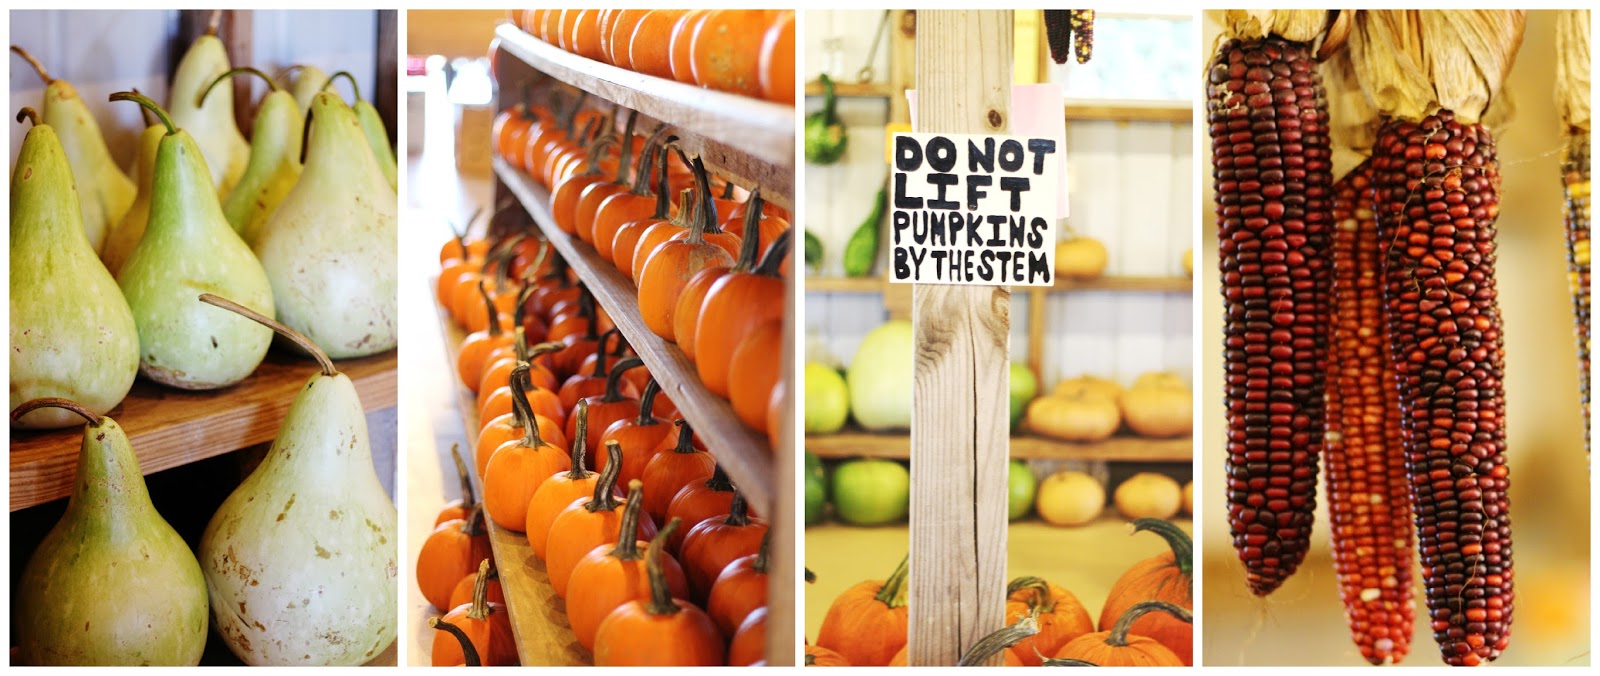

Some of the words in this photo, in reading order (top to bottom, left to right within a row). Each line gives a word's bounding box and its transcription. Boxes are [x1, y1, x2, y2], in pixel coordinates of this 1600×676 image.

[895, 135, 957, 172] DO
[968, 137, 1056, 175] NOT
[894, 172, 1030, 212] LIFT
[893, 210, 1048, 249] PUMPKINS
[894, 246, 927, 280] BY
[930, 249, 975, 282] THE
[977, 249, 1050, 284] STEM
